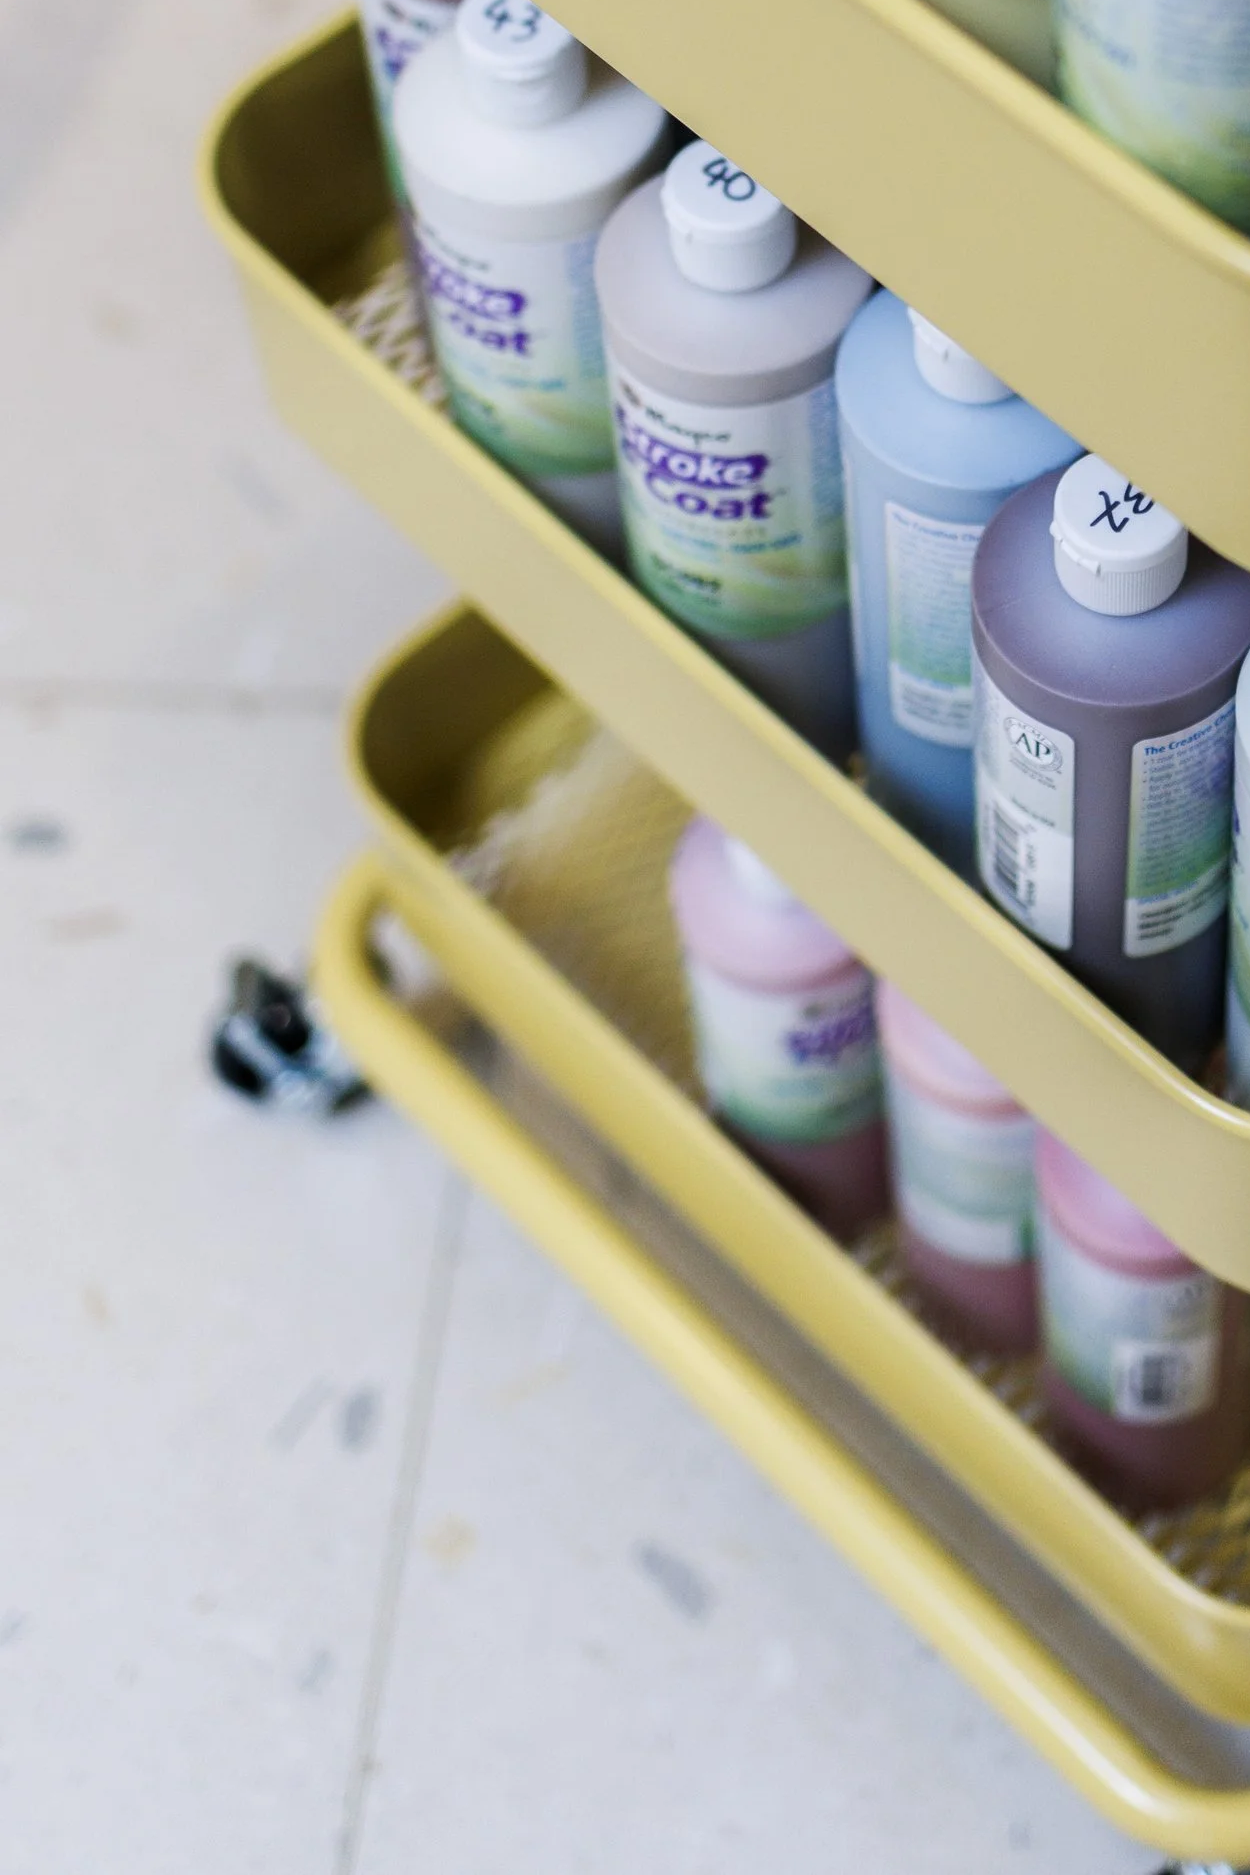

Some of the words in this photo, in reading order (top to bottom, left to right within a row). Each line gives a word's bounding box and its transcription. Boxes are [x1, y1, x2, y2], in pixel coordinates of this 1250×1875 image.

[702, 158, 757, 202] 40
[1089, 481, 1156, 533] 37
[1015, 732, 1051, 761] AP
[1145, 745, 1166, 755] The
[1169, 724, 1212, 749] Creative
